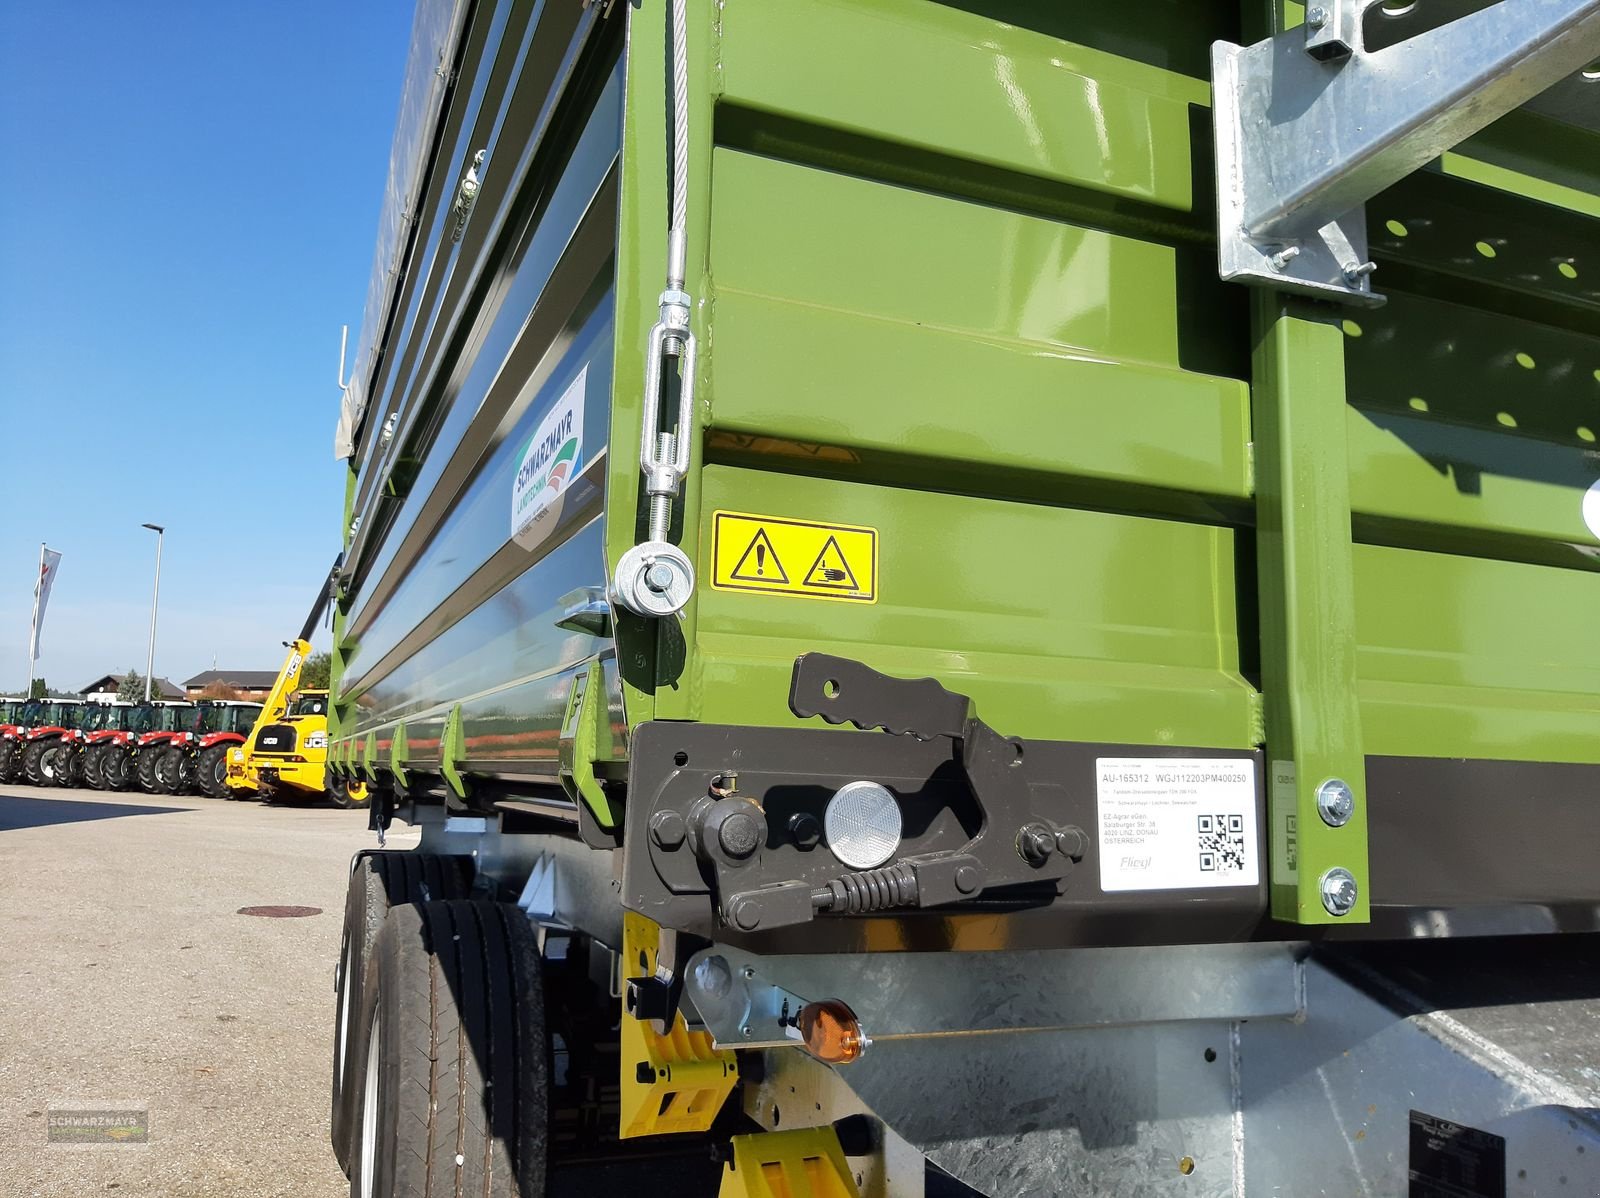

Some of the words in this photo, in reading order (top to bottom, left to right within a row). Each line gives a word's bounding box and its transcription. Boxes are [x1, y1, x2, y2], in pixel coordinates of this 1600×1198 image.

[517, 409, 573, 493] SCHWARZMAYR
[517, 473, 547, 515] LANDTECHNIK
[286, 654, 302, 679] JCB
[263, 737, 278, 745] JCB
[1102, 773, 1149, 783] AU-165312
[1104, 821, 1135, 829] Salzburger
